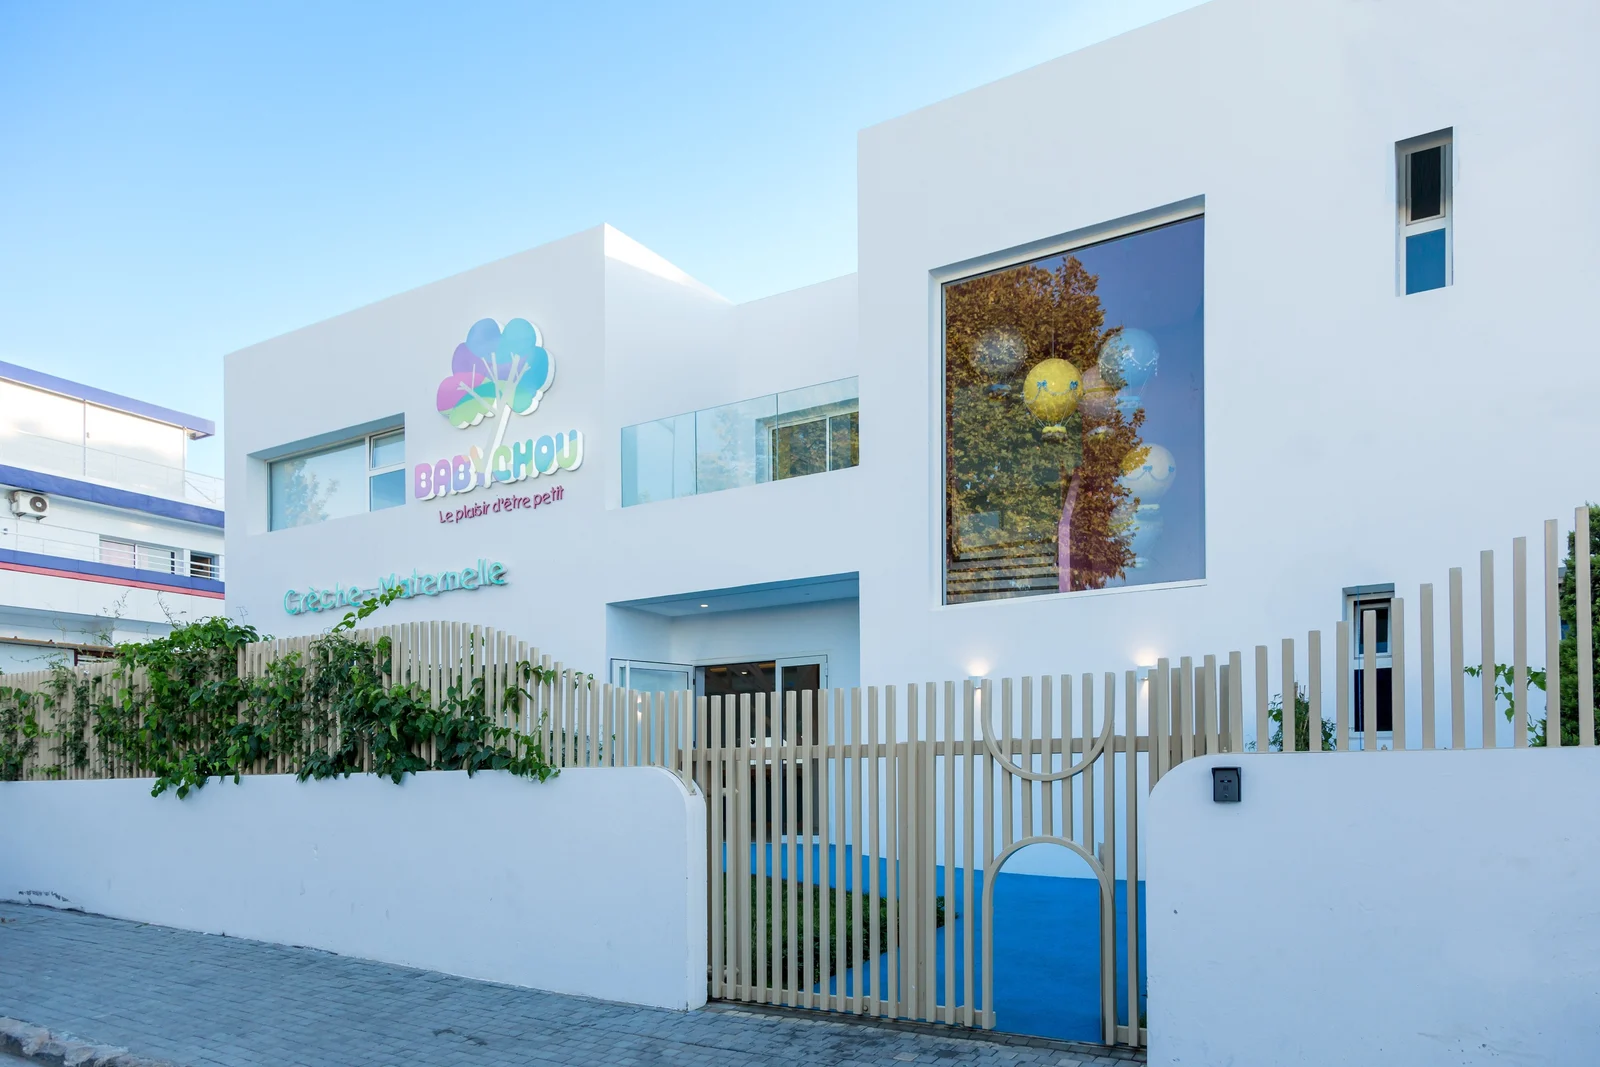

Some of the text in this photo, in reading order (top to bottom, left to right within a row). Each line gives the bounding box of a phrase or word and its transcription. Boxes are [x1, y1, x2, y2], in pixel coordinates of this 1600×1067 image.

[439, 485, 565, 524] Le plaisir d'être petit
[283, 582, 363, 615] Crèche
